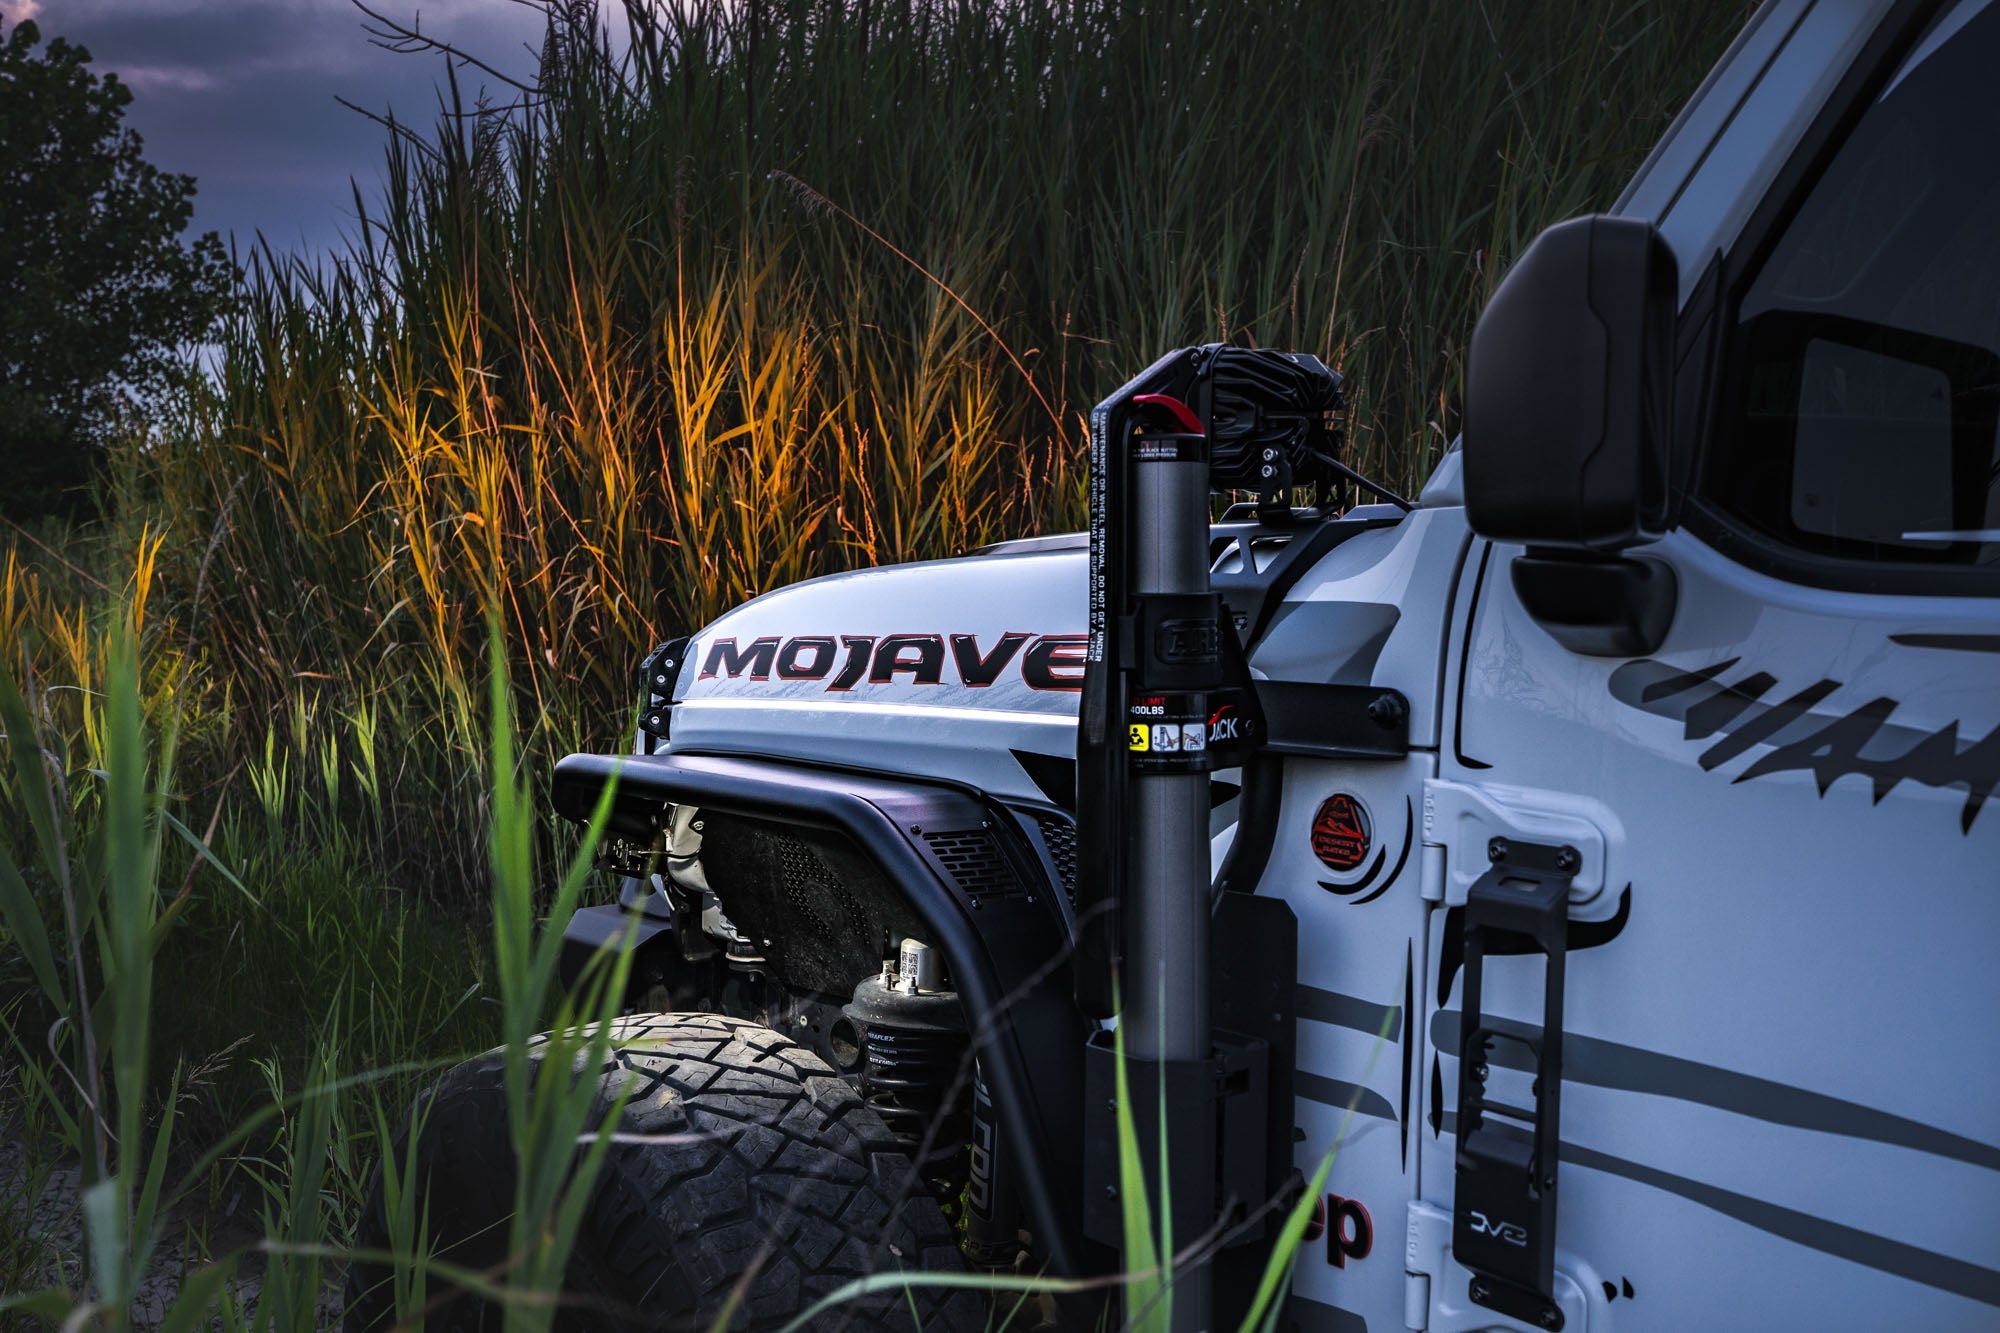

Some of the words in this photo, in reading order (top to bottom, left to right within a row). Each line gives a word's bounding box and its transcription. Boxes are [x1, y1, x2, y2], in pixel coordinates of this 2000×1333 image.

[1091, 466, 1098, 474] A
[1099, 478, 1106, 491] OR
[1091, 543, 1098, 552] IS
[1098, 575, 1105, 588] DO
[1091, 612, 1097, 625] BY
[1088, 638, 1096, 662] JACK
[1095, 631, 1104, 662] UNDER
[698, 632, 1088, 691] MOJAVE
[1209, 717, 1239, 742] JACK
